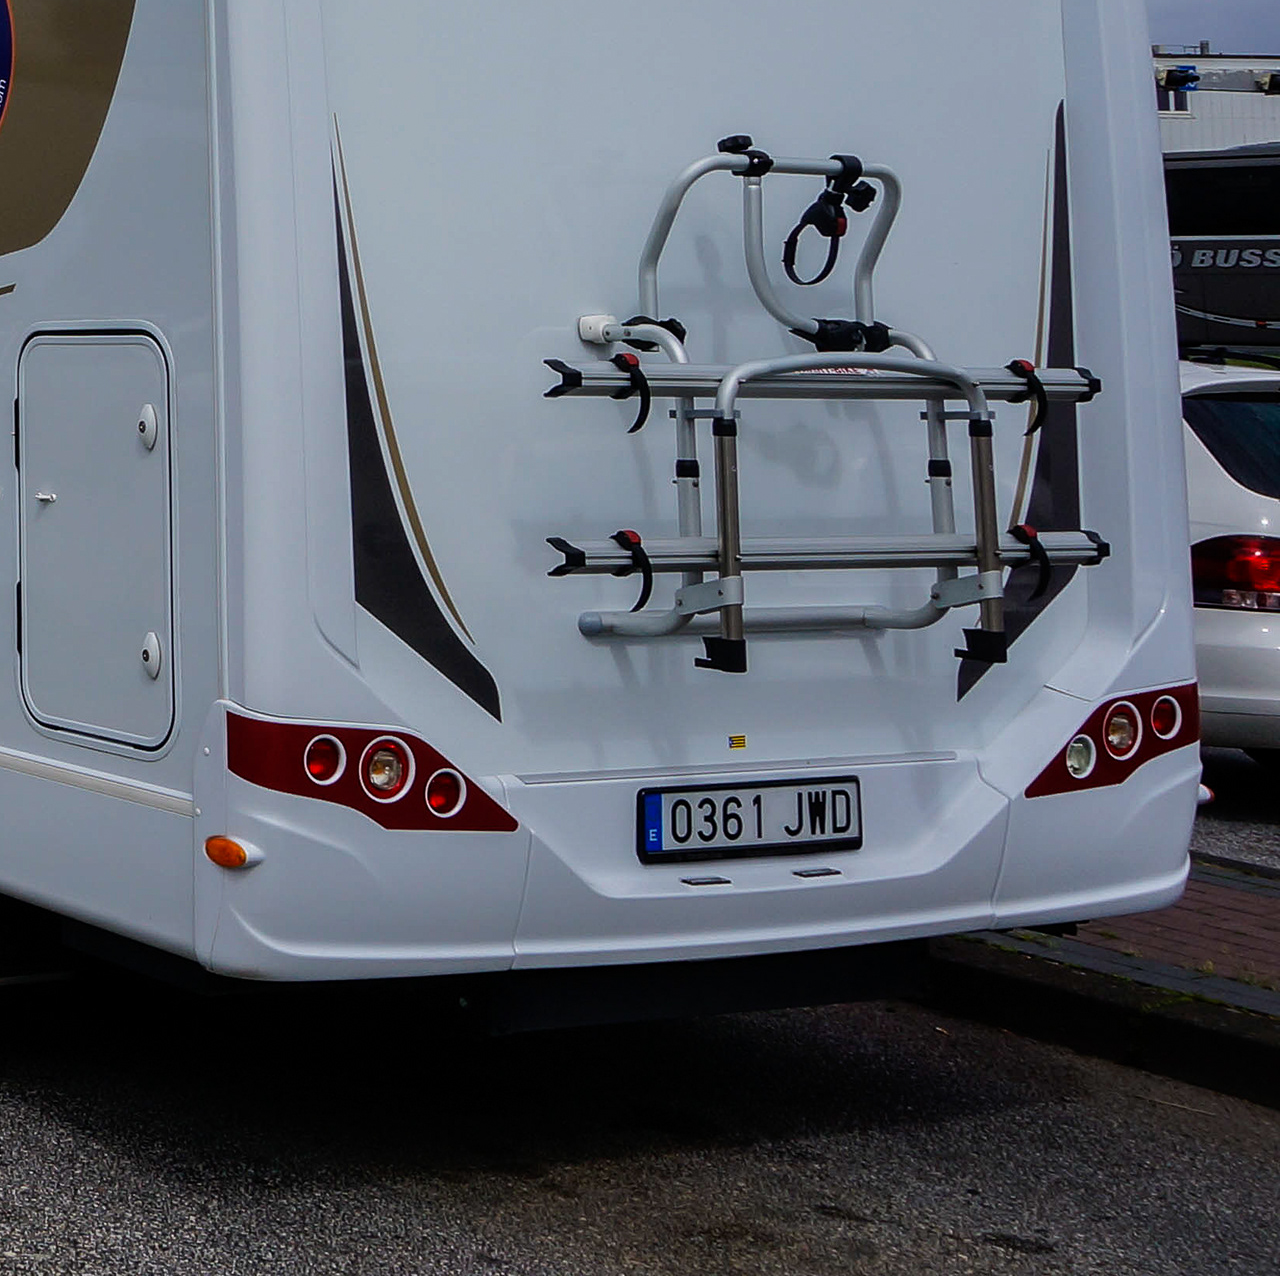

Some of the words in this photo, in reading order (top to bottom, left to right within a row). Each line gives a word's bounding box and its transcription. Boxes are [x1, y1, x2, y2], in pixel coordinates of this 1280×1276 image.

[1191, 248, 1280, 268] BUSS
[649, 829, 658, 842] E
[670, 793, 763, 844] 0361
[783, 789, 852, 838] JWD
